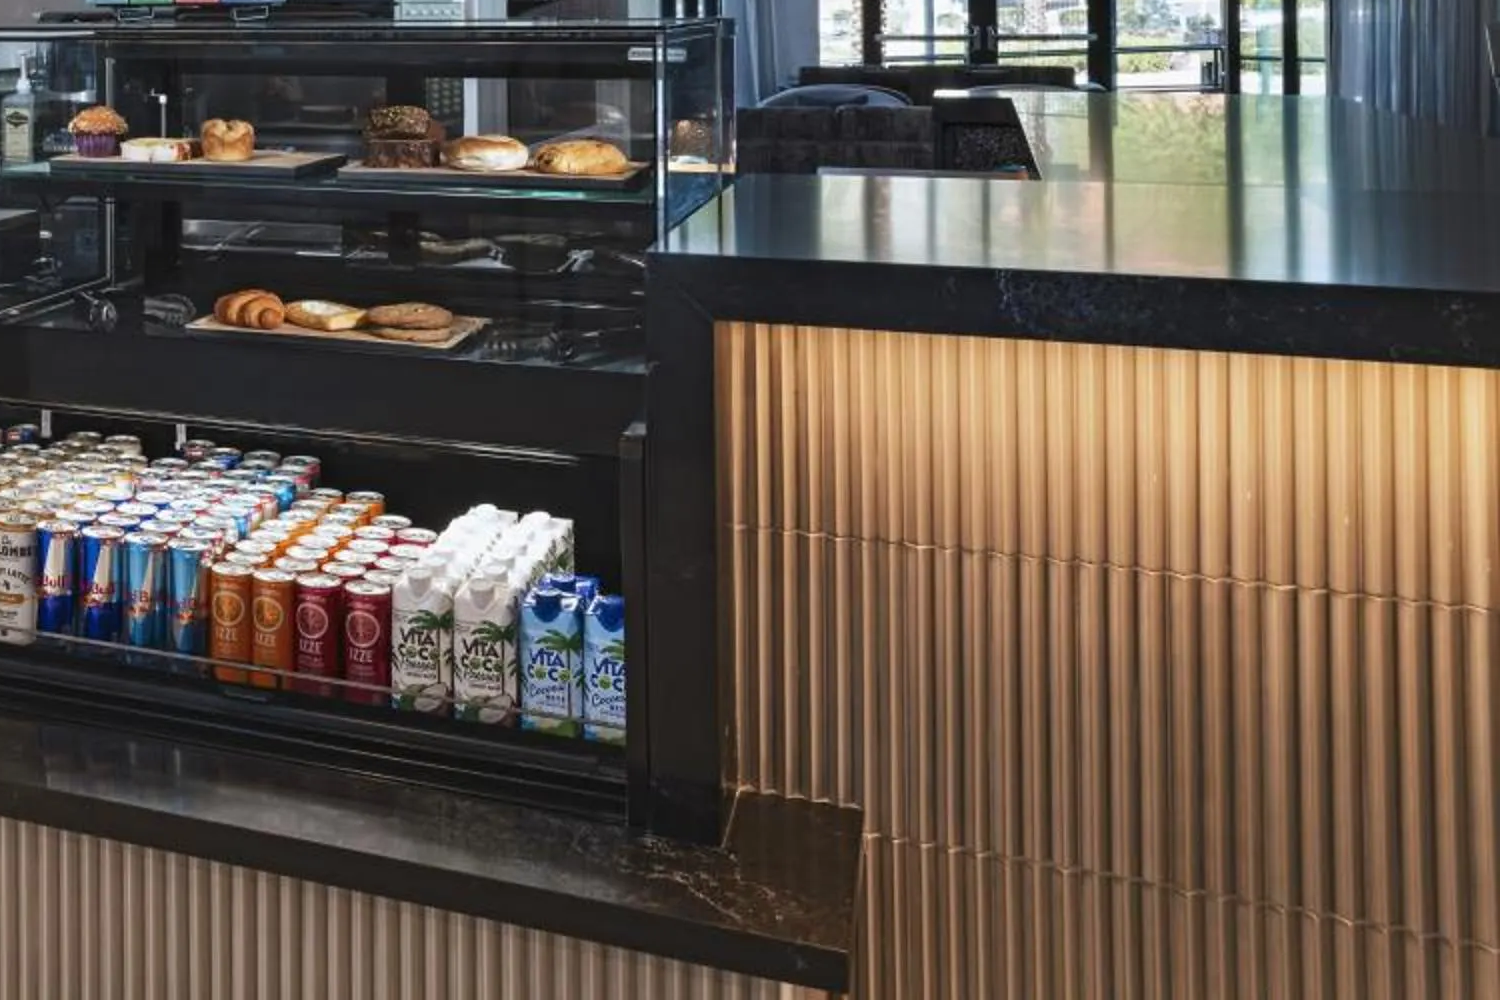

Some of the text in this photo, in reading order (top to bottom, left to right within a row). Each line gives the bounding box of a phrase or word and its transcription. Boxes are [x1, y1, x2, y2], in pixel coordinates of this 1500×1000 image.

[400, 627, 435, 647] VITA
[348, 647, 373, 663] IZZE
[462, 638, 499, 659] VITA
[529, 648, 565, 668] VITA
[591, 674, 623, 692] COC
